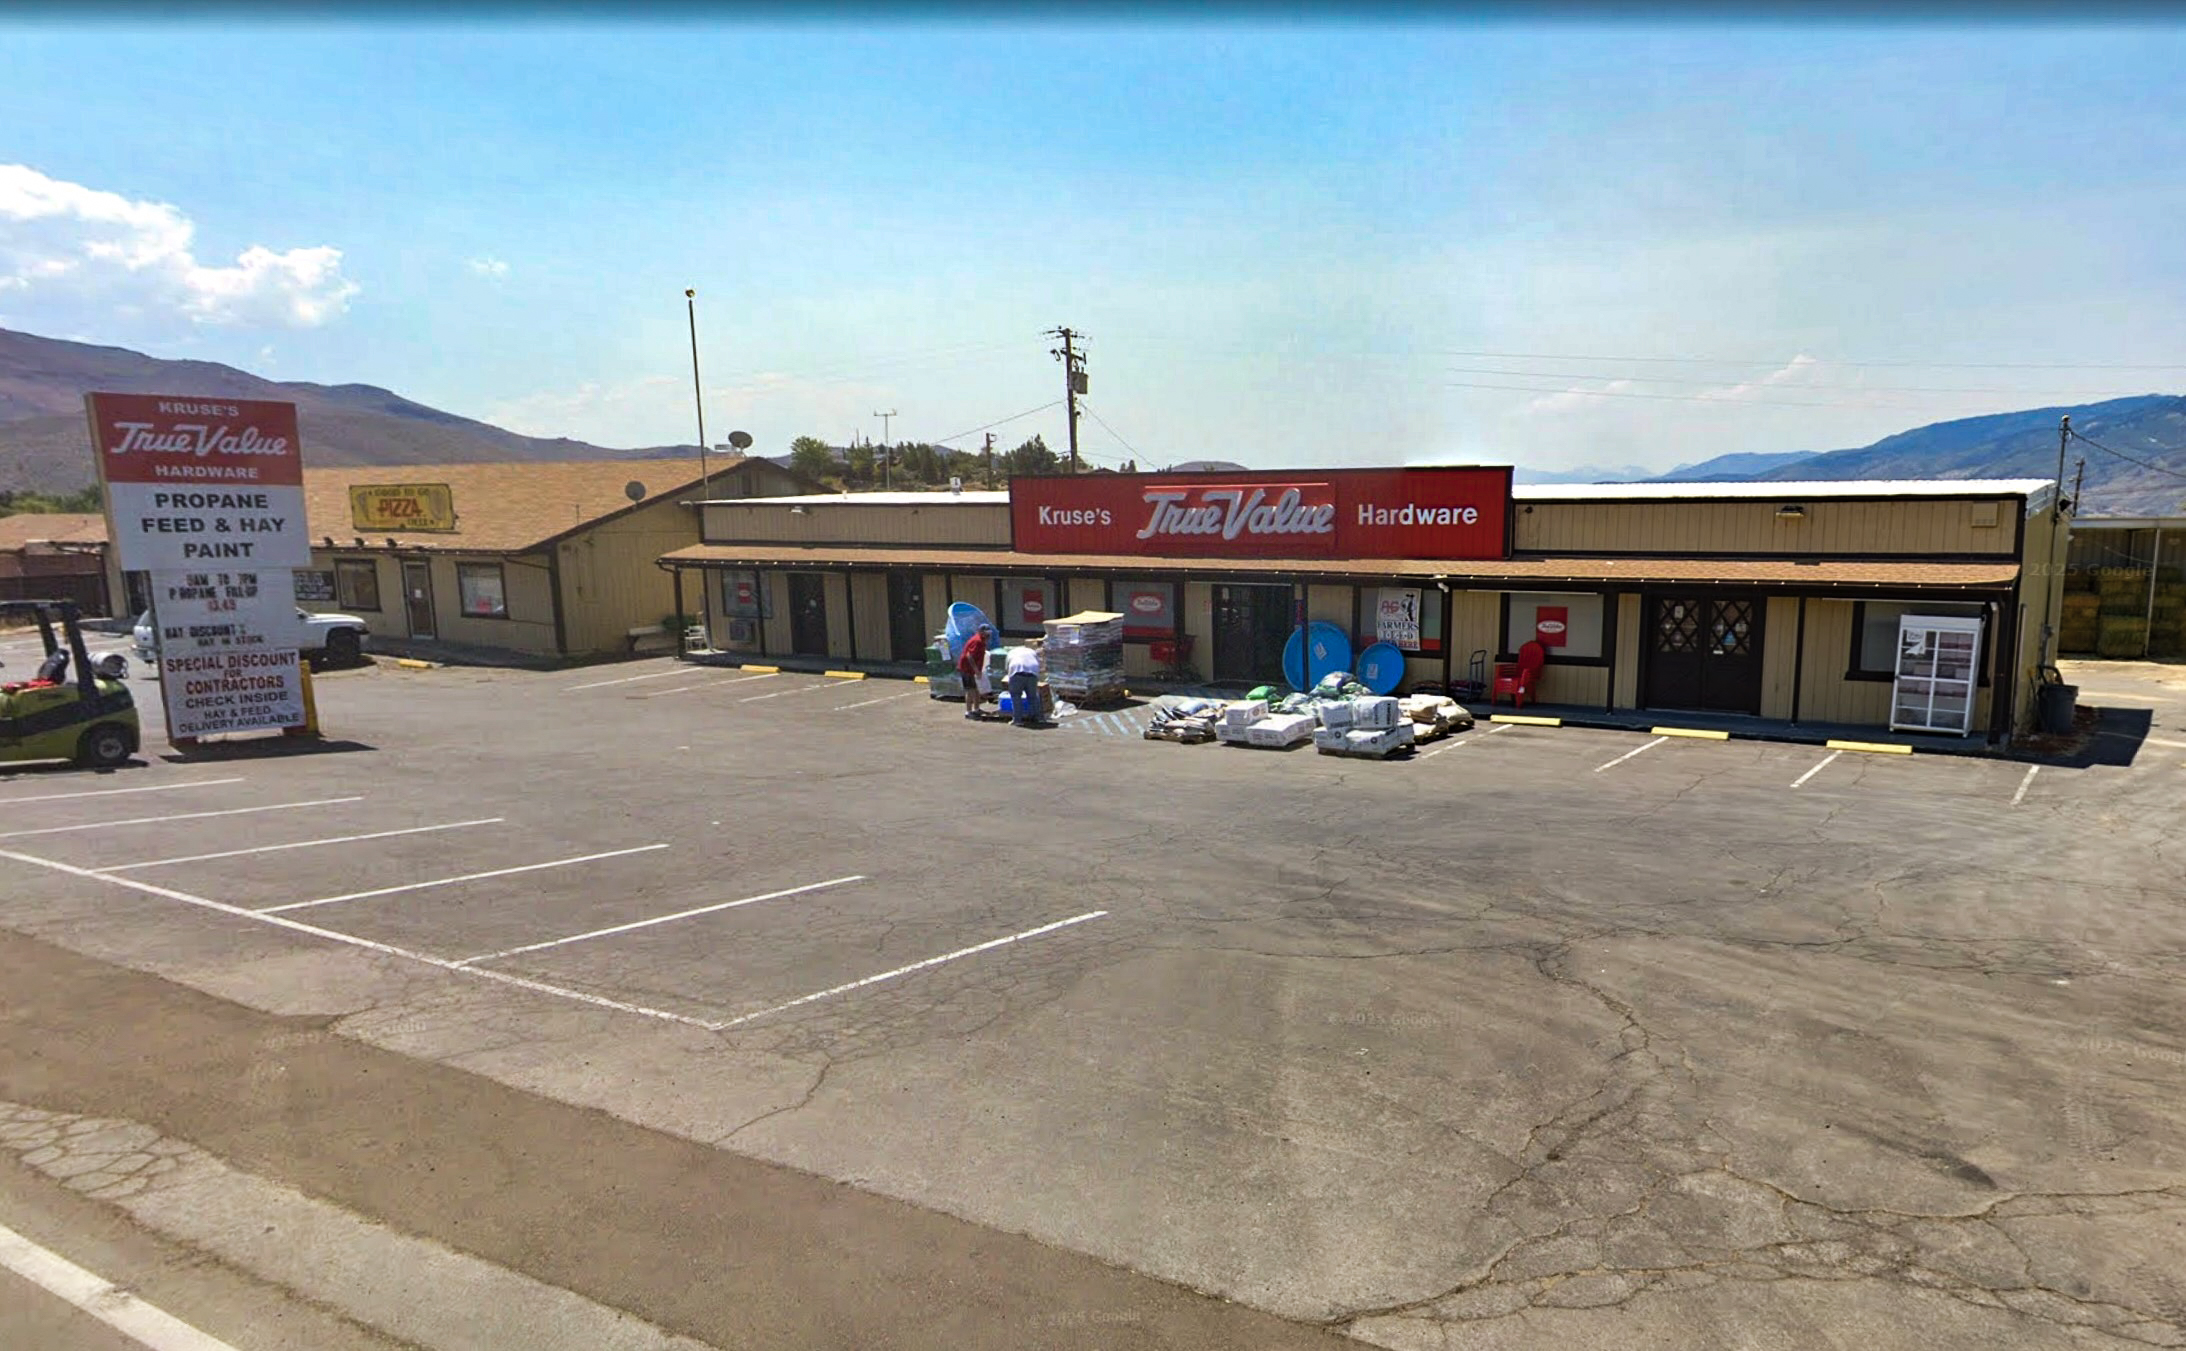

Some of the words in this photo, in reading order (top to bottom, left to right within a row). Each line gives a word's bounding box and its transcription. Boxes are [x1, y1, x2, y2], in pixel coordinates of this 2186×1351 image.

[158, 401, 239, 417] KRUSE'S
[154, 465, 259, 480] HARDWARE
[154, 493, 269, 510] PROPANE
[1038, 505, 1112, 526] Kruse's
[1357, 503, 1479, 526] Hardware
[141, 517, 205, 534] FEED
[214, 518, 232, 533] &
[240, 518, 286, 533] HAY
[183, 542, 254, 560] PAINT
[166, 655, 224, 673] SPECIAL
[228, 652, 296, 670] DISCOUNT
[185, 675, 285, 695] CONTRACTORS
[185, 693, 235, 709] CHECK
[239, 691, 288, 704] INSIDE
[204, 708, 228, 719] HAY
[231, 708, 239, 718] &
[241, 705, 271, 716] FEED
[178, 718, 236, 734] DELIVERY
[237, 713, 299, 727] AVAILABLE
